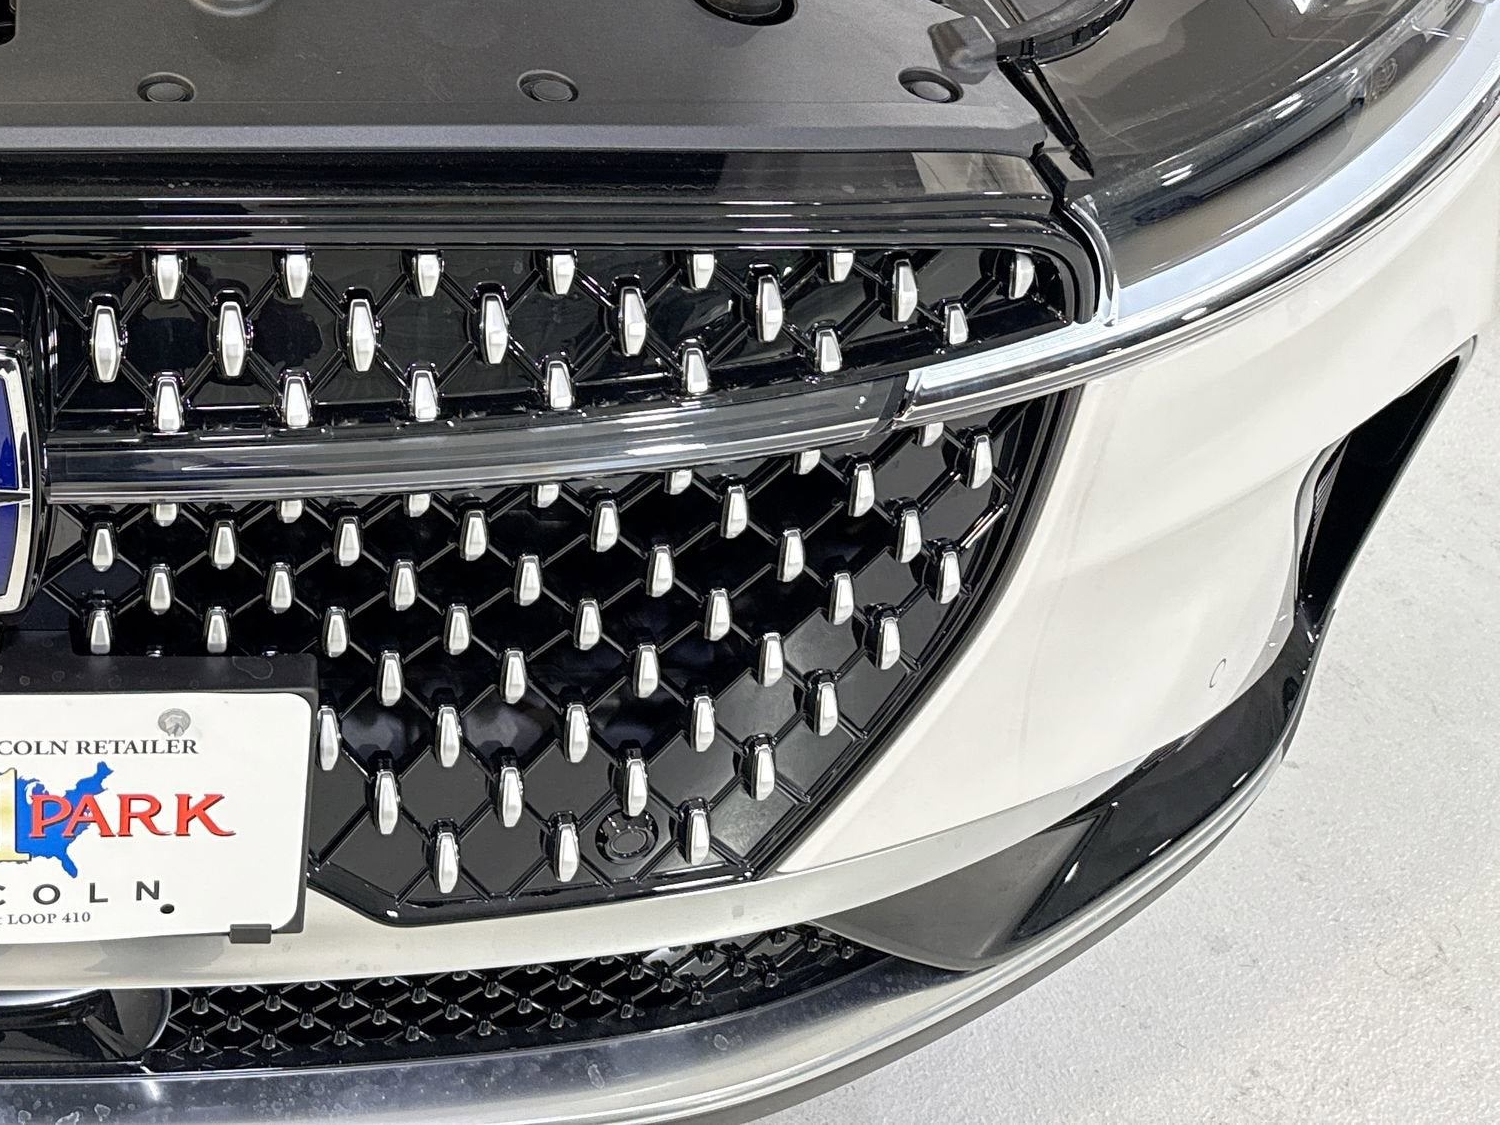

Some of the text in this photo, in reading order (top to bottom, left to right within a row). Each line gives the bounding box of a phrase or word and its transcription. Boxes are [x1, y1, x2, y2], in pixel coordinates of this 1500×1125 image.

[78, 740, 196, 754] RETAILER
[29, 794, 236, 837] PARK
[9, 914, 56, 924] LOOP
[63, 913, 90, 922] 410
